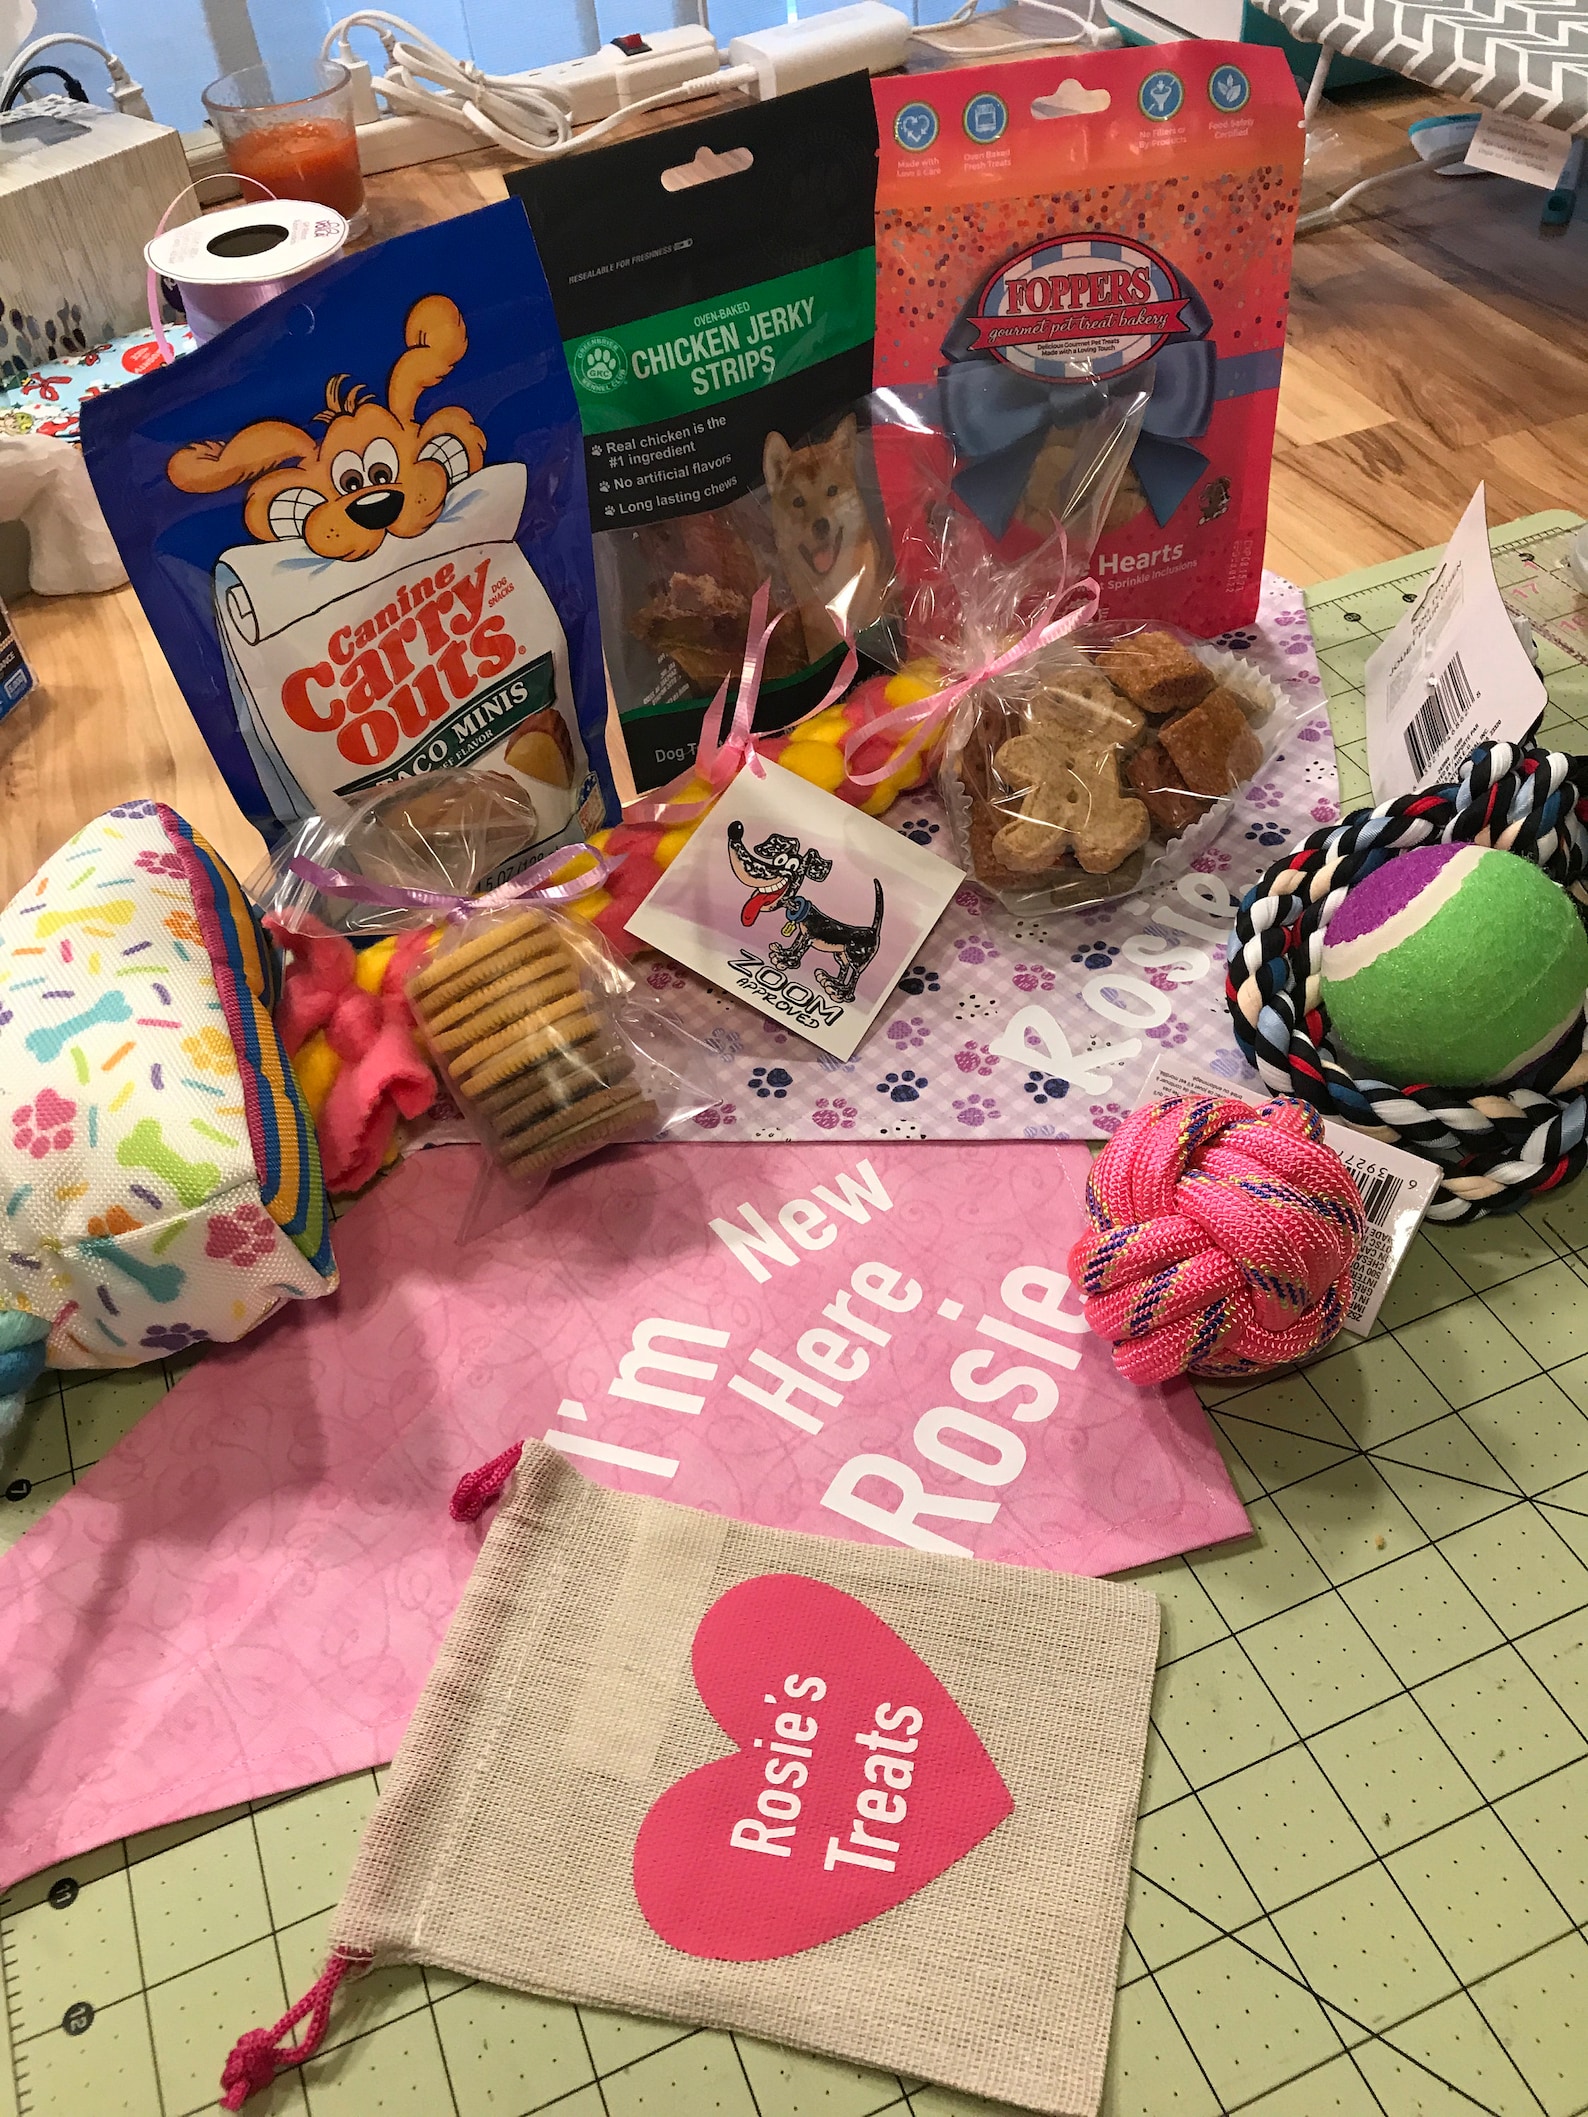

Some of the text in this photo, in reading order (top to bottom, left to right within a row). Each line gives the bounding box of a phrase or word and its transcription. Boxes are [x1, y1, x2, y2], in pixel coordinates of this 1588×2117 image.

[568, 244, 673, 285] RESEALABLE FOR FRESHNESS
[1005, 266, 1151, 314] FOPPERS
[693, 301, 750, 328] OVEN-BAKED
[988, 307, 1168, 344] gourmet pet treat bakery
[631, 296, 815, 380] CHICKEN JERKY
[1064, 340, 1090, 348] Gourmet
[690, 345, 776, 396] STRIPS
[605, 415, 727, 454] Real chicken is the
[608, 441, 697, 469] #1 ingredient
[613, 452, 732, 491] No artificial flavors
[618, 475, 738, 516] Long lasting chews
[1098, 542, 1184, 576] Hearts
[1107, 573, 1151, 591] Sprinkle
[1151, 559, 1198, 579] Inclusions
[487, 582, 515, 608] SNACKS
[490, 576, 508, 594] DOG
[1512, 581, 1540, 599] 17
[328, 562, 456, 665] Canine
[0, 651, 16, 672] ANCE
[451, 681, 529, 743] MINIS
[456, 729, 494, 760] FLAVOR
[655, 748, 685, 764] Dog
[727, 948, 845, 1026] ZOOM
[988, 872, 1239, 1096] Rosie
[736, 977, 821, 1029] APPROVED
[1408, 1179, 1418, 1190] 6
[1356, 1253, 1386, 1271] CHESA
[1366, 1268, 1382, 1280] 500
[1380, 1253, 1389, 1264] IN
[1351, 1270, 1378, 1289] INTER
[542, 1157, 895, 1478] I'm New
[1359, 1296, 1370, 1306] IN
[727, 1261, 924, 1435] Here
[820, 1264, 1094, 1560] Rosie
[730, 1673, 827, 1857] Rosie's
[823, 1701, 924, 1873] Treats
[56, 1884, 72, 1904] 11
[69, 2005, 88, 2032] 12
